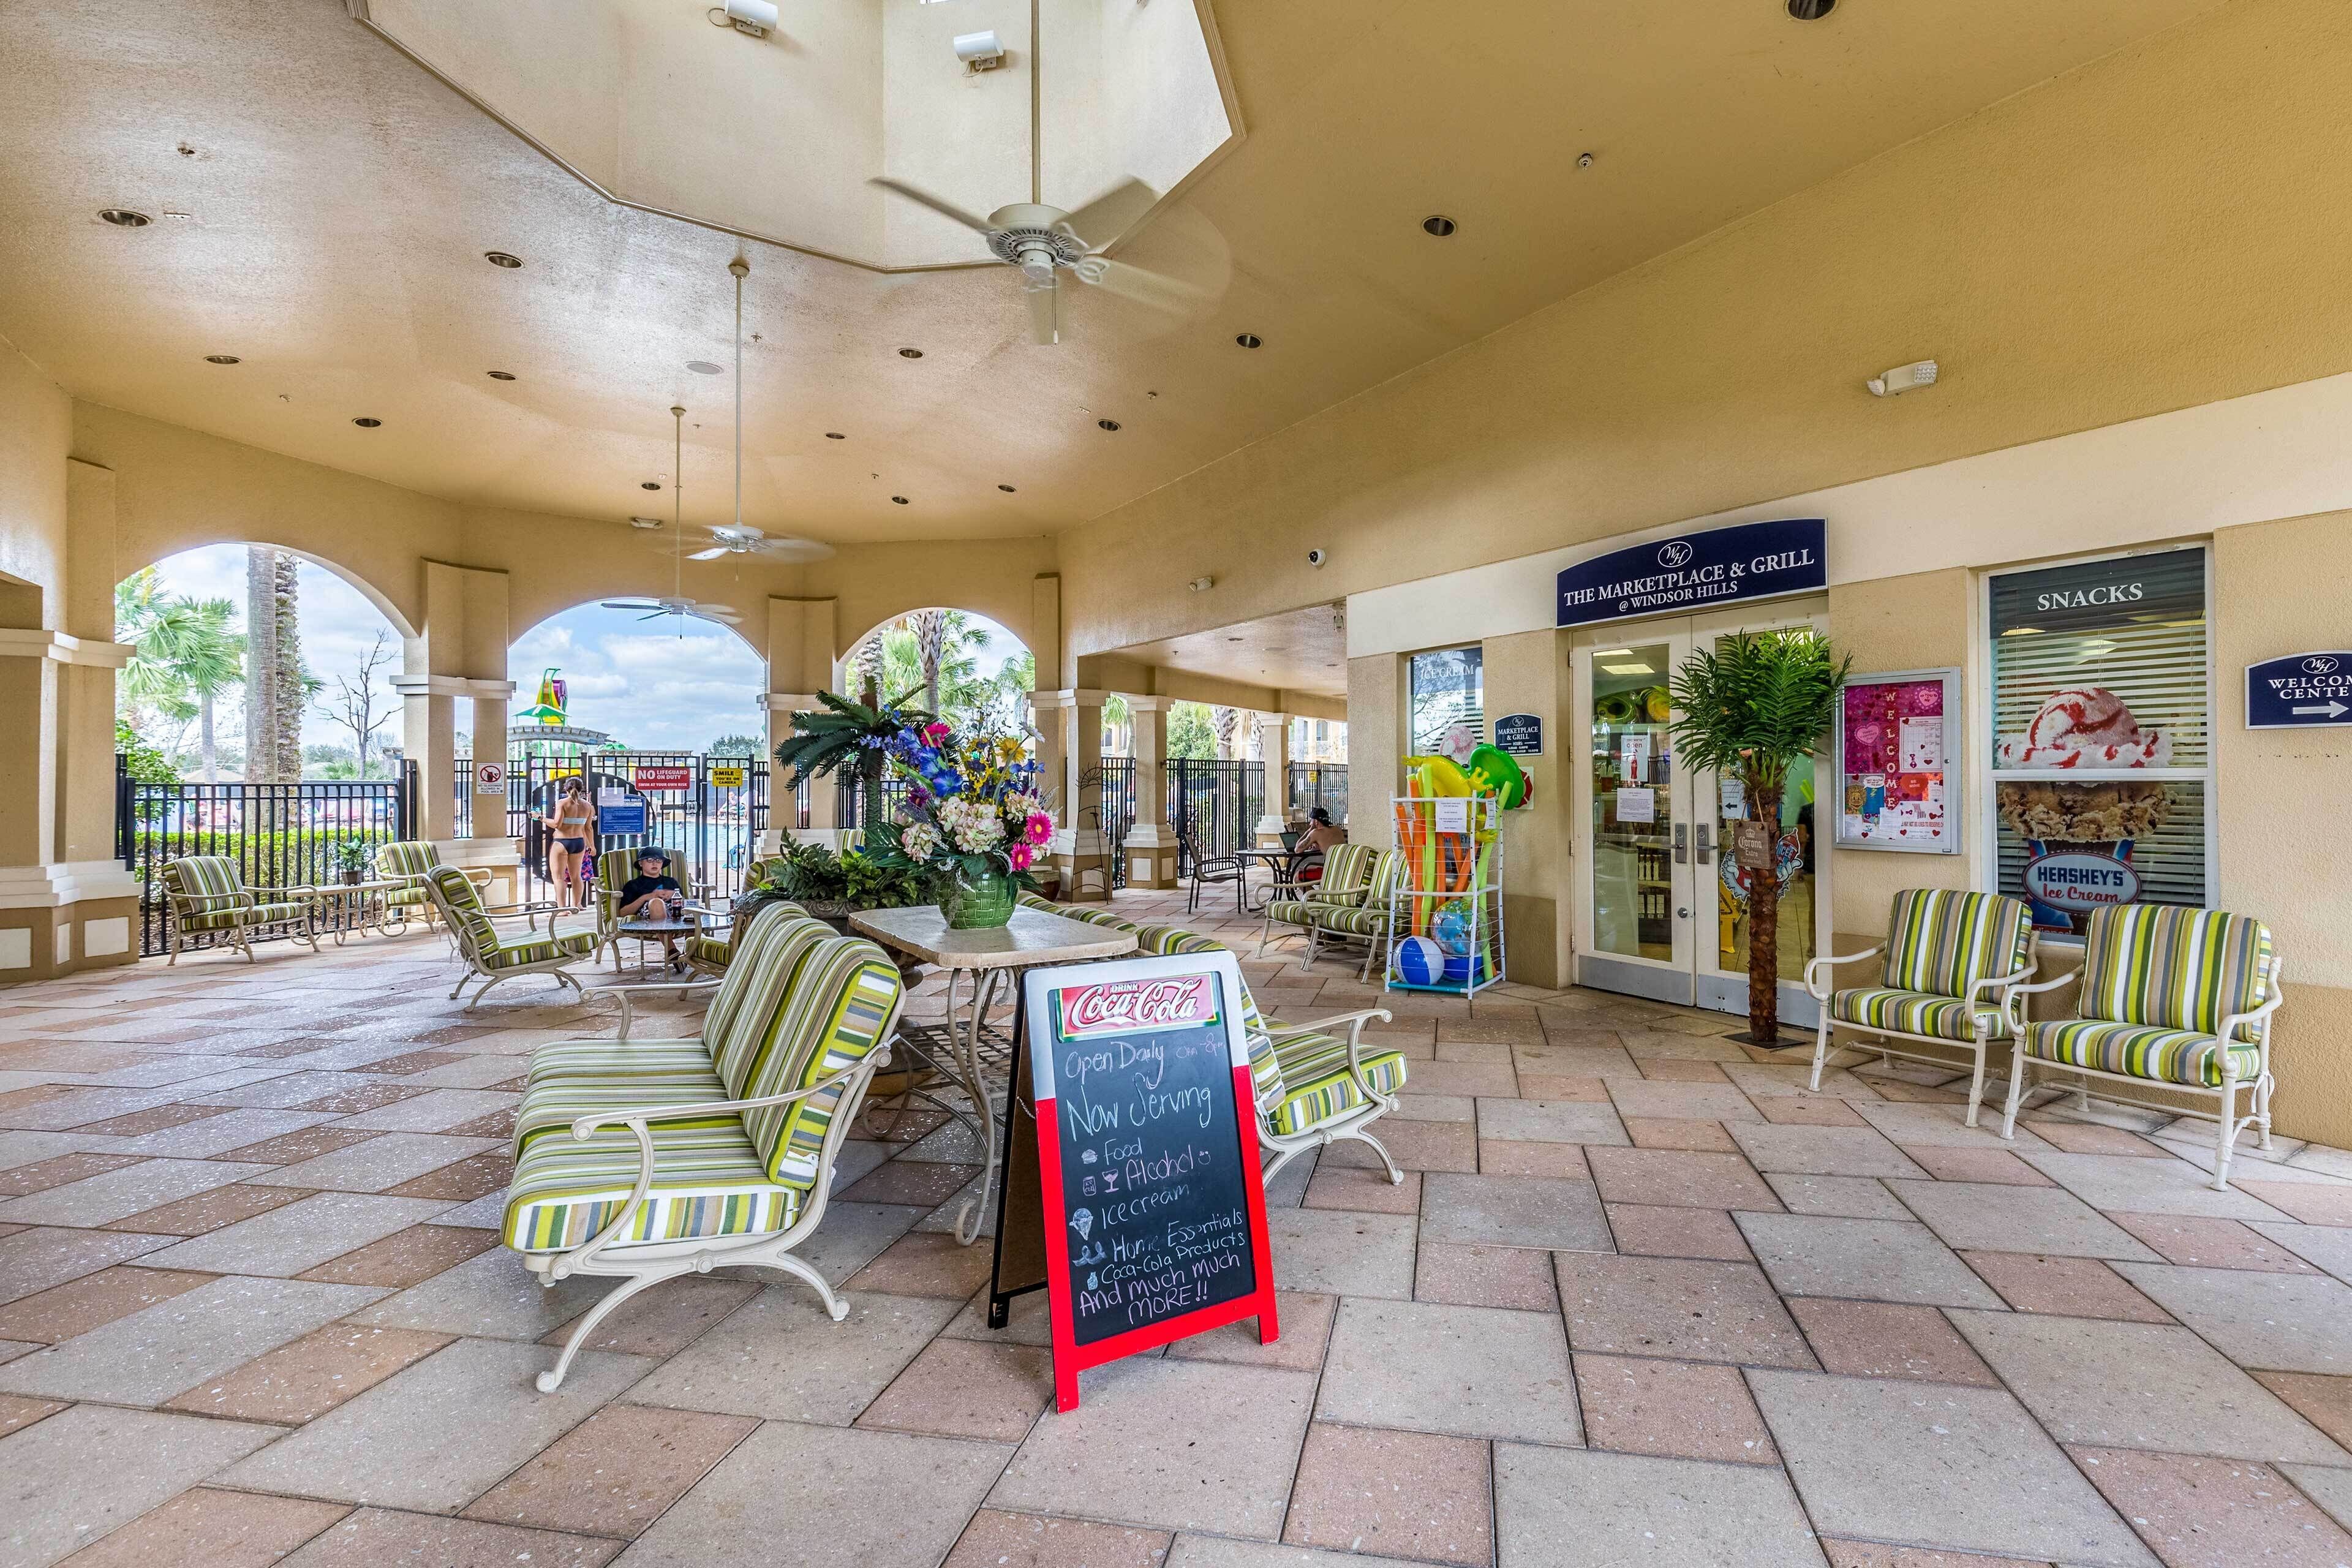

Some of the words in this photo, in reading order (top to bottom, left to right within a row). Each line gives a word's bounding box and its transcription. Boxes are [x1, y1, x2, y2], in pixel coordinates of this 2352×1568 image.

[1564, 588, 1595, 606] THE
[1598, 564, 1725, 600] MARKETPLACE
[1730, 562, 1746, 578] &
[1751, 549, 1815, 573] GRILL
[1619, 600, 1629, 612] @
[1630, 589, 1694, 608] WINDSOR
[1697, 581, 1738, 598] HILLS
[2037, 583, 2143, 611] SNACKS
[1421, 665, 1436, 679] ICE
[1439, 664, 1474, 677] CREAM
[1886, 692, 1898, 807] WELCOME
[638, 770, 655, 780] NO
[1738, 836, 1763, 849] Corona
[1745, 848, 1758, 857] Extra
[2038, 866, 2124, 886] HERSHEY'S
[2043, 883, 2064, 899] Ice
[2068, 886, 2121, 903] Cream
[1110, 983, 1139, 993] DRINK
[1071, 978, 1202, 1028] Coca-Cola
[1065, 1052, 1113, 1085] Open
[1110, 1039, 1164, 1090] Daily
[1066, 1085, 1118, 1142] Now
[1129, 1072, 1212, 1128] Serving
[1104, 1137, 1142, 1166] Food
[1126, 1144, 1194, 1191] Alcohol
[1101, 1254, 1172, 1284] Coca-Cola
[1176, 1232, 1245, 1259] Products
[1112, 1234, 1160, 1262] Home
[1079, 1280, 1122, 1317] And
[1128, 1266, 1185, 1301] much
[1192, 1249, 1240, 1278] much
